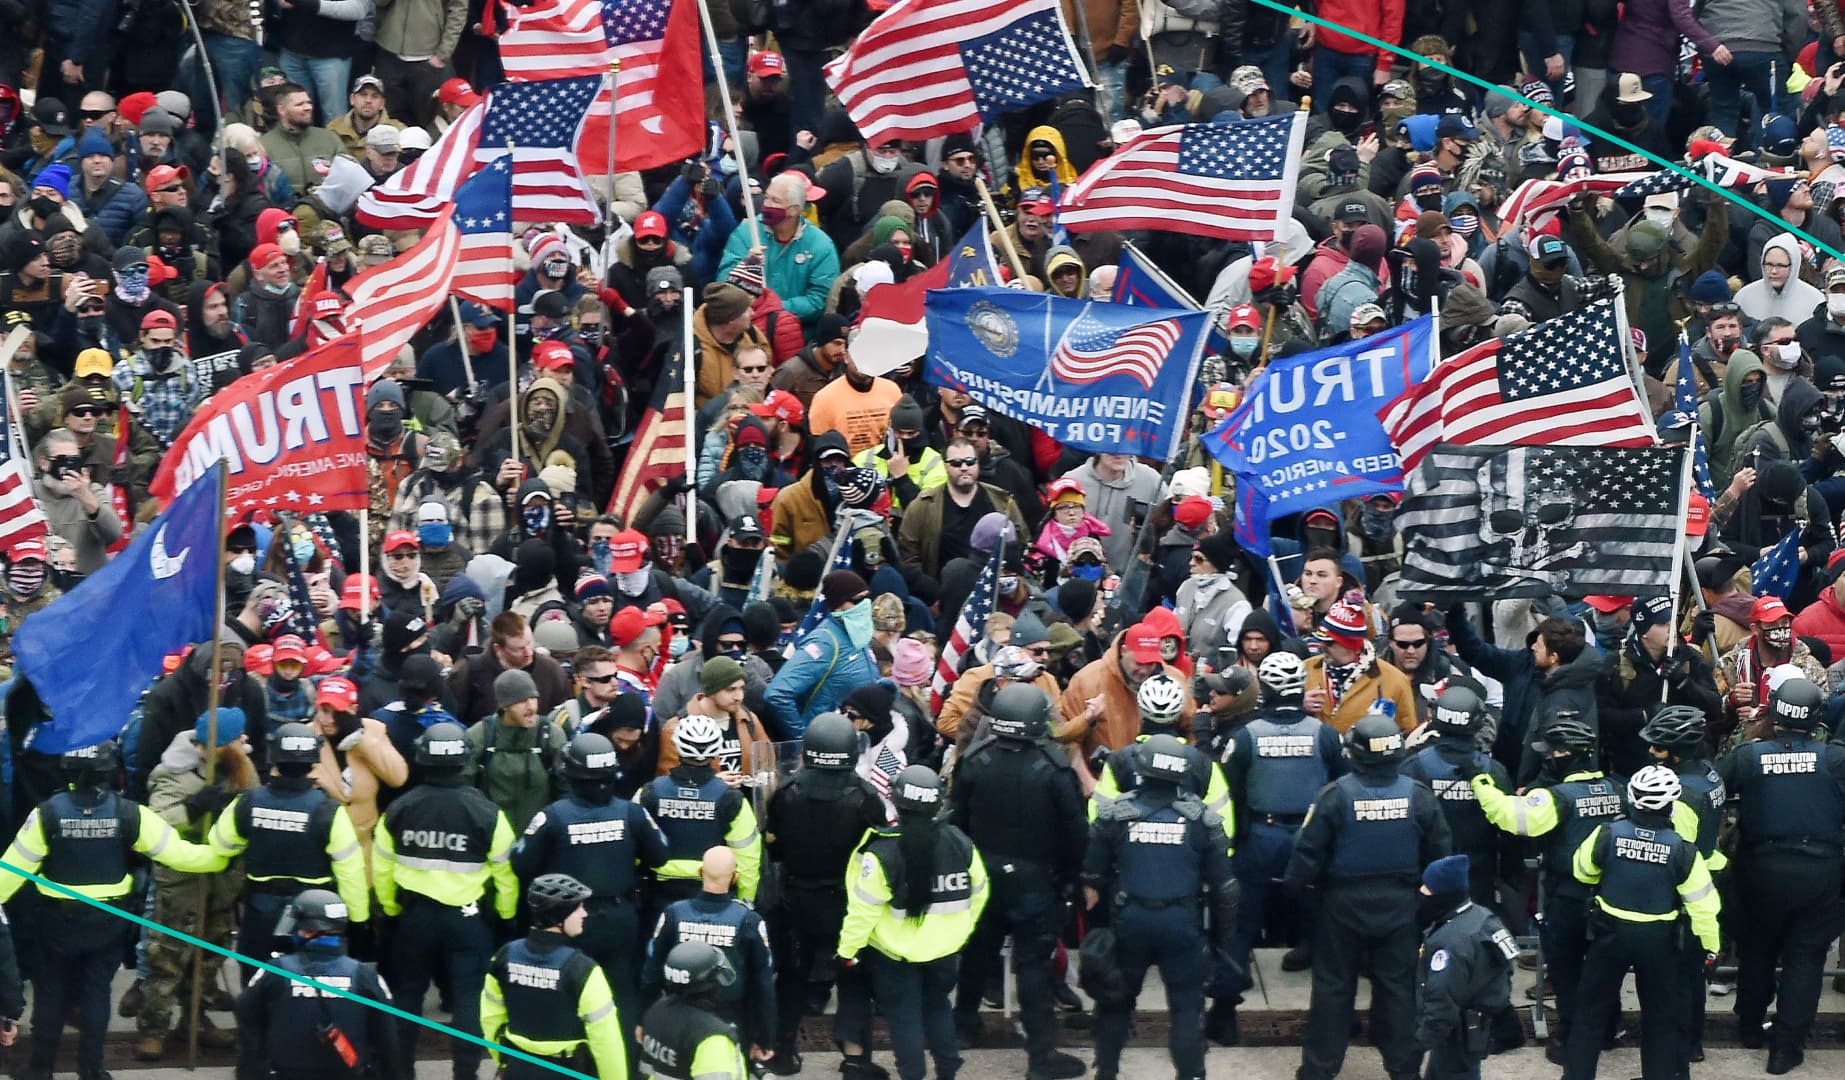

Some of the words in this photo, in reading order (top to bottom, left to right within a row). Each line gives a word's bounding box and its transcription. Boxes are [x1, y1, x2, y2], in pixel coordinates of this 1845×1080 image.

[1436, 706, 1470, 725] MPDC
[1776, 699, 1809, 719] MPDC
[1259, 746, 1313, 757] POLICE
[1761, 752, 1817, 765] METROPOLITAN
[1763, 762, 1816, 775] POLICE
[658, 798, 716, 811] METROPOLITAN
[1576, 795, 1622, 808] METROPOLITAN
[658, 808, 716, 820] POLICE
[1356, 809, 1409, 821] POLICE
[1579, 804, 1622, 817] POLICE
[402, 829, 469, 852] POLICE
[1616, 837, 1671, 855] METROPOLITAN
[1616, 848, 1669, 864] POLICE
[930, 872, 969, 893] LICE
[643, 1034, 678, 1068] OLICE
